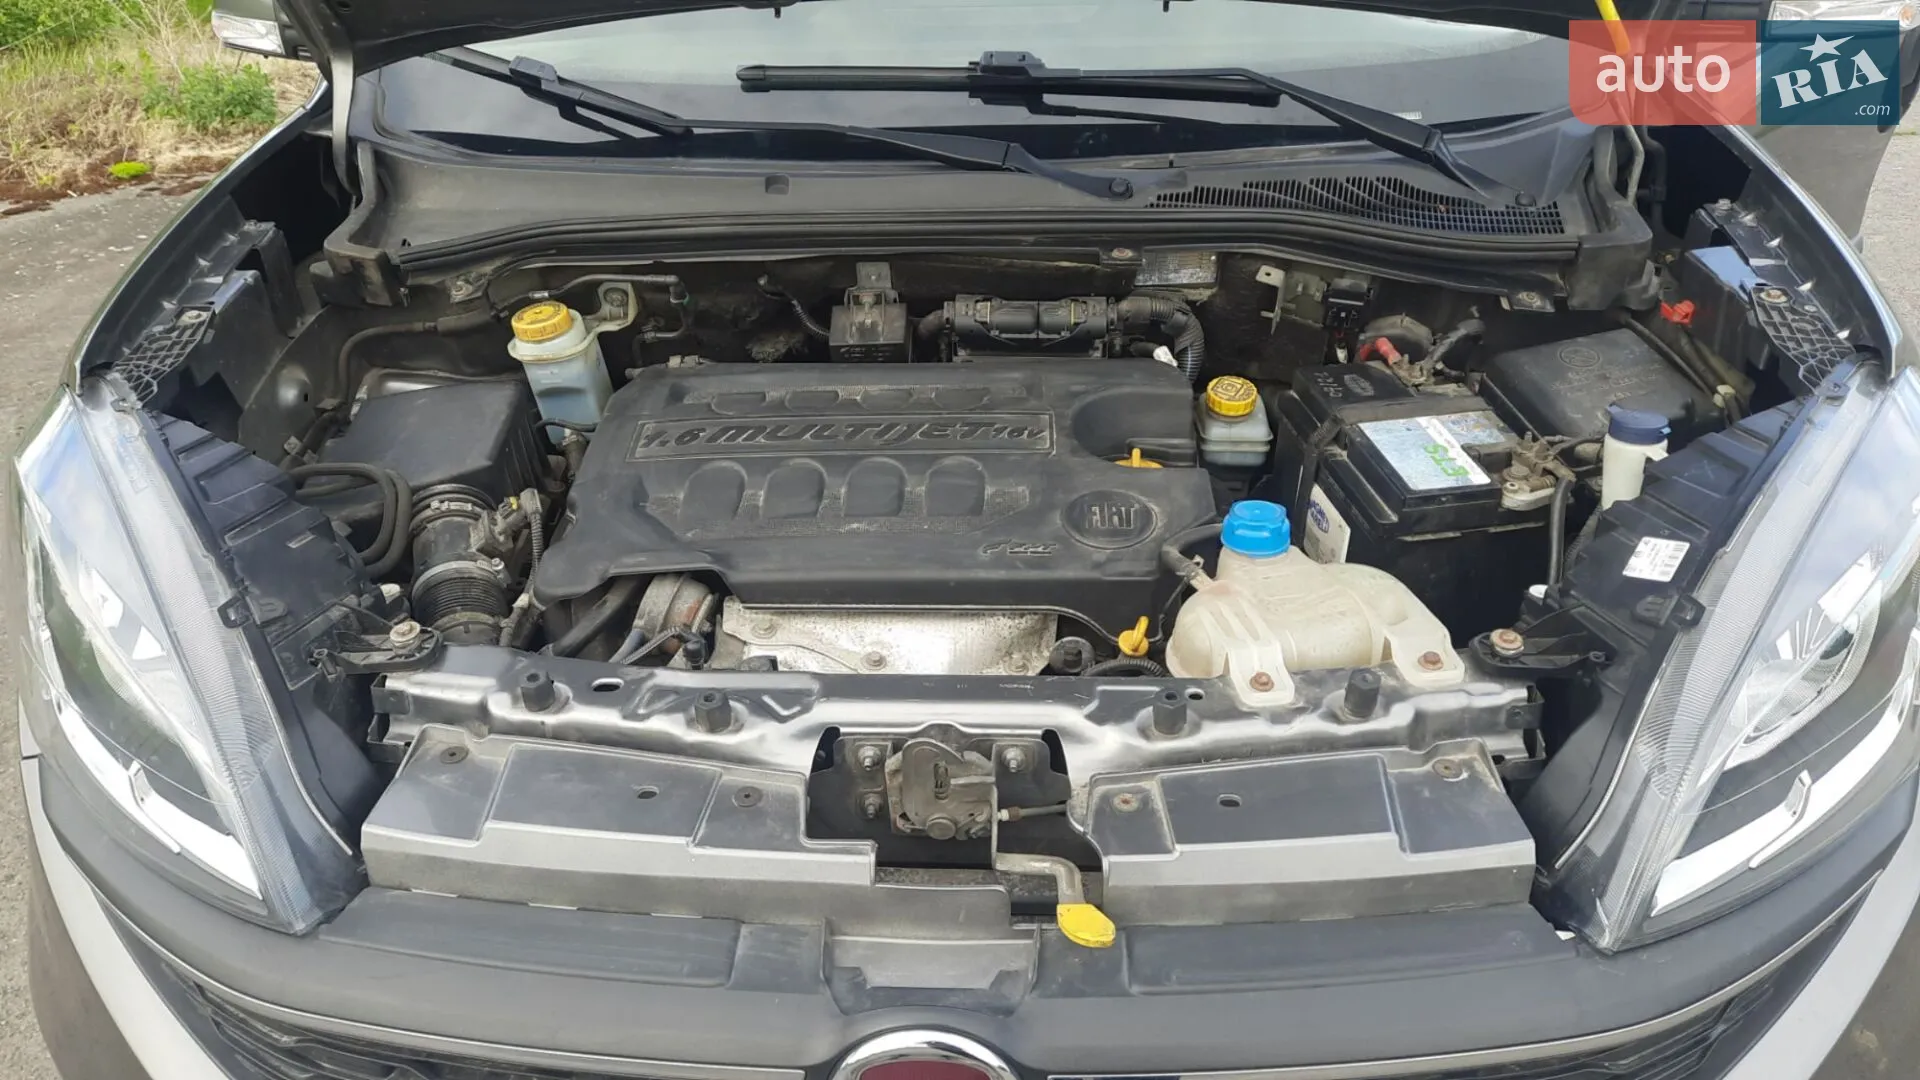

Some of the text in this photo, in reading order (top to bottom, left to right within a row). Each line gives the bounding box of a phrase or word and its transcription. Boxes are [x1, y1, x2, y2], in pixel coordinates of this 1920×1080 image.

[639, 427, 706, 449] 1.6
[704, 421, 998, 446] MULTIJET
[1086, 503, 1136, 529] FIAT
